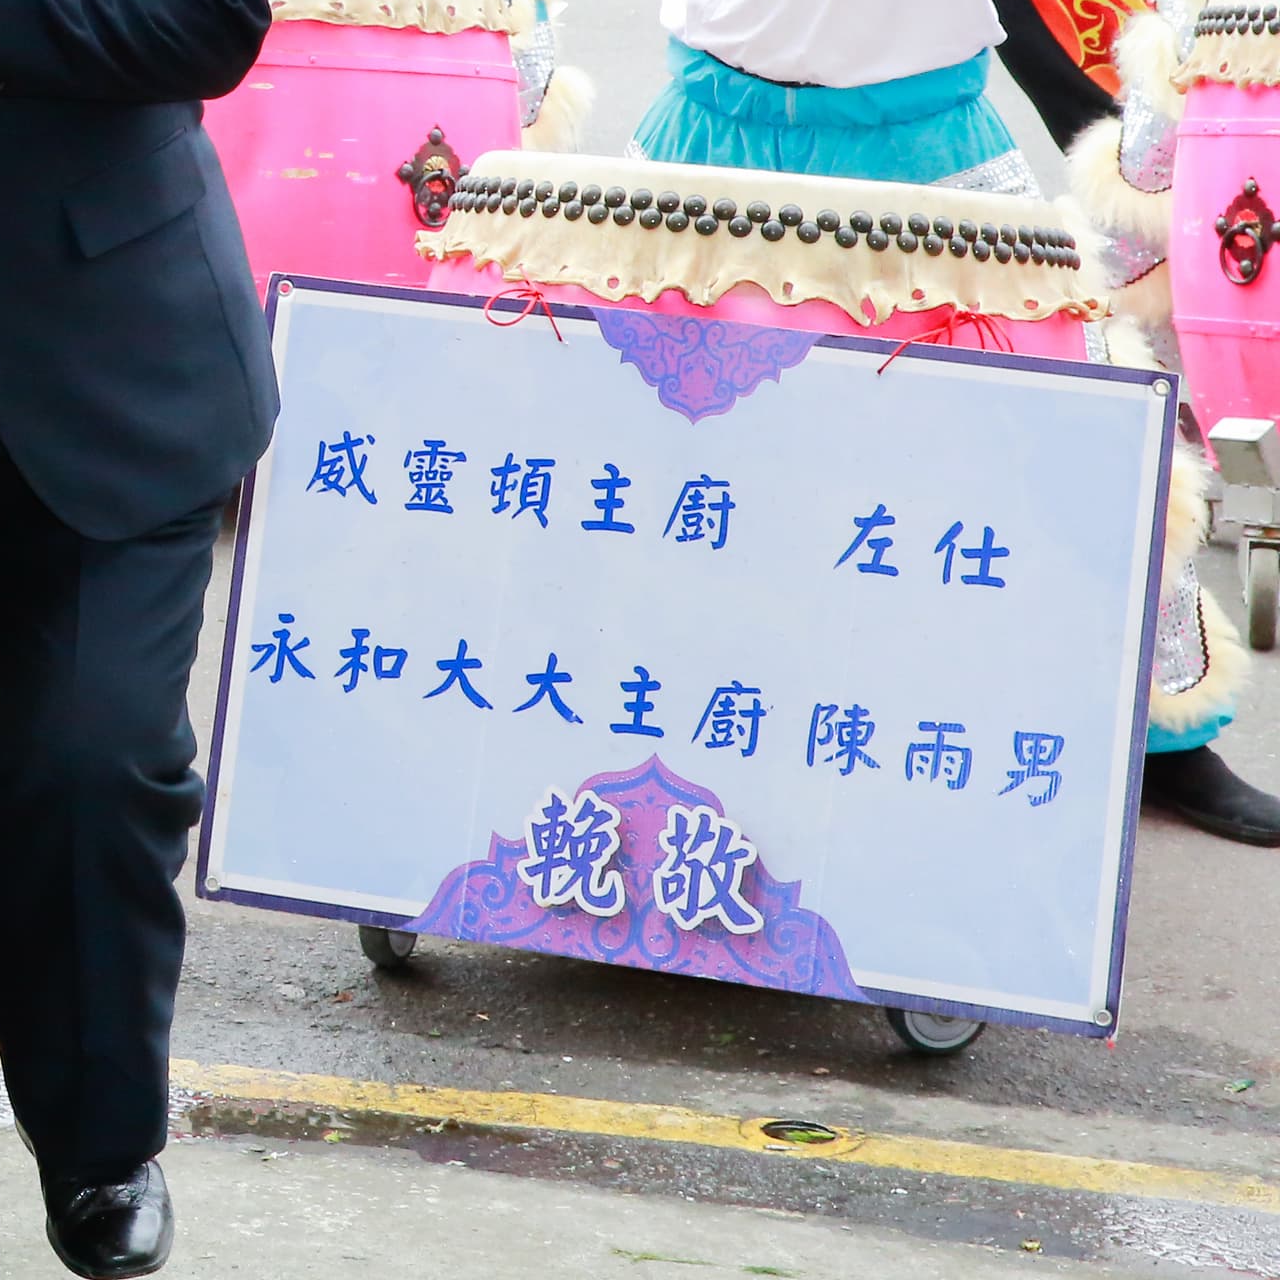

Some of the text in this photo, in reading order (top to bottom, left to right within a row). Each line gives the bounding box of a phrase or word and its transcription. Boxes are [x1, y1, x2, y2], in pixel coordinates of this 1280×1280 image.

[305, 430, 1010, 588] 威靈頓主廚 左仕
[249, 613, 1065, 807] 永和大大主廚陳雨男
[520, 788, 761, 931] 輓敬
